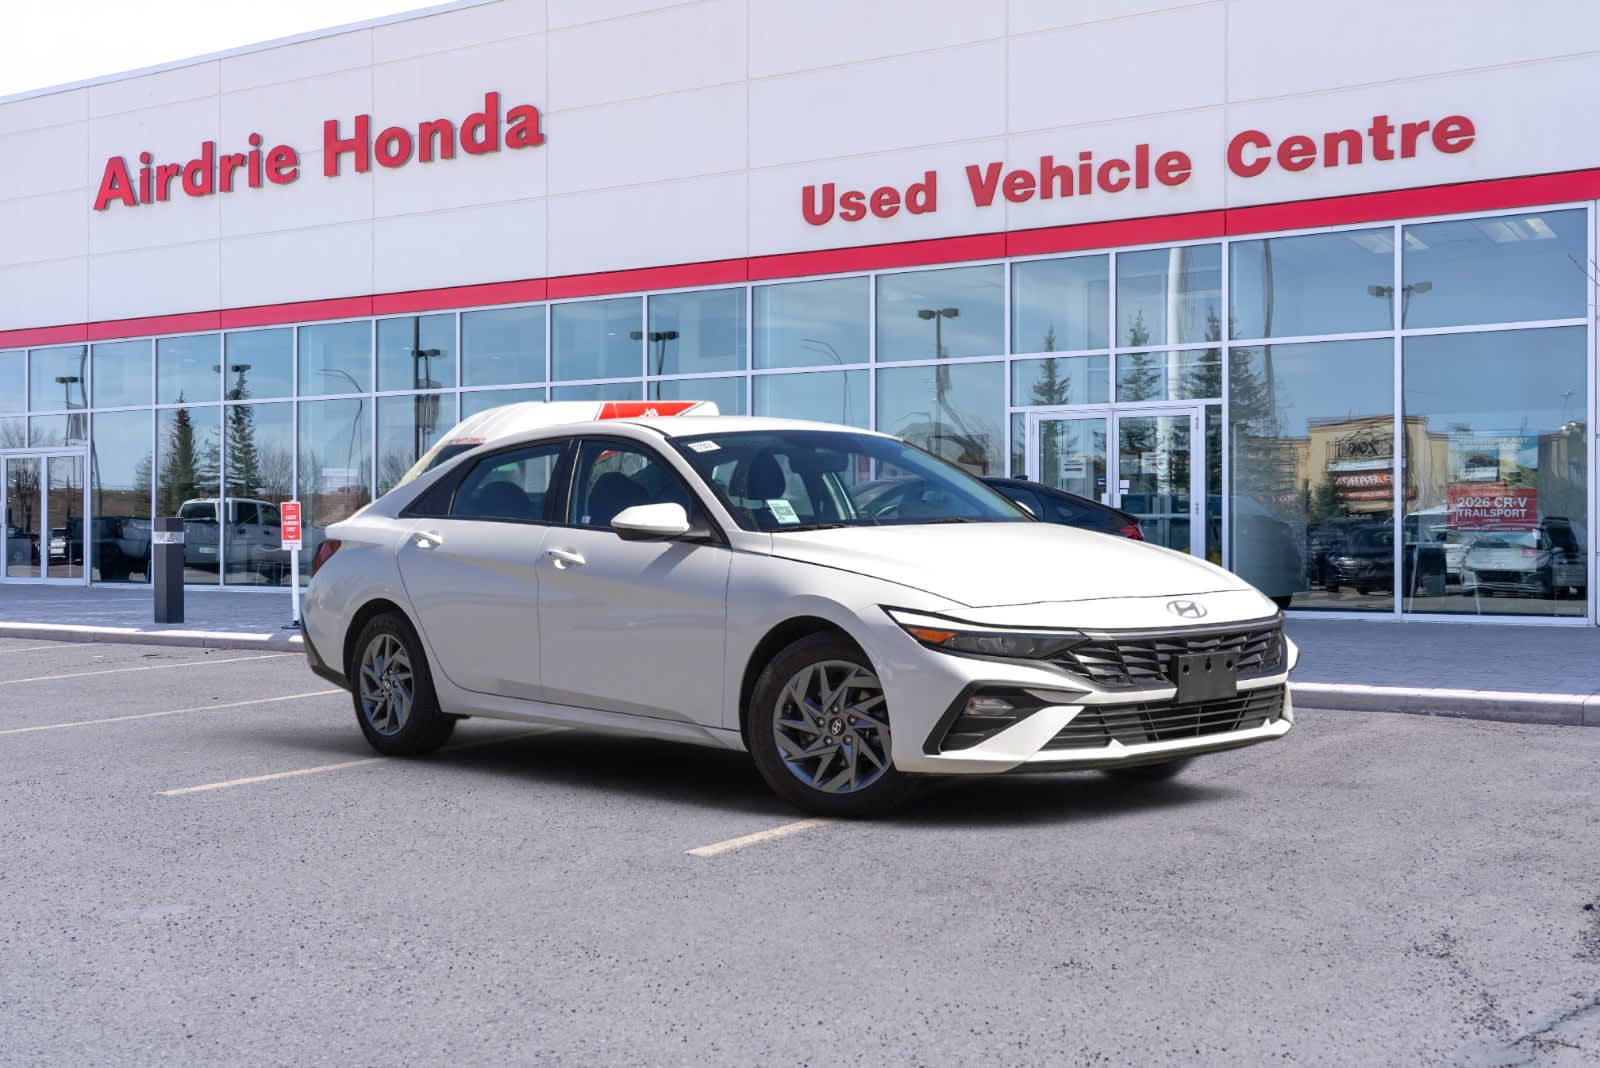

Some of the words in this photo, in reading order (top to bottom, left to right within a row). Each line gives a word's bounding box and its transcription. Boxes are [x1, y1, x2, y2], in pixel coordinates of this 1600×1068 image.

[94, 133, 299, 211] Airdrie
[323, 91, 547, 177] Honda
[802, 171, 937, 226] Used
[965, 143, 1192, 207] Vehicle
[1227, 115, 1476, 178] Centre
[1456, 496, 1491, 508] 2026
[1494, 496, 1528, 508] CR-V
[1457, 508, 1528, 518] TRAILSPORT
